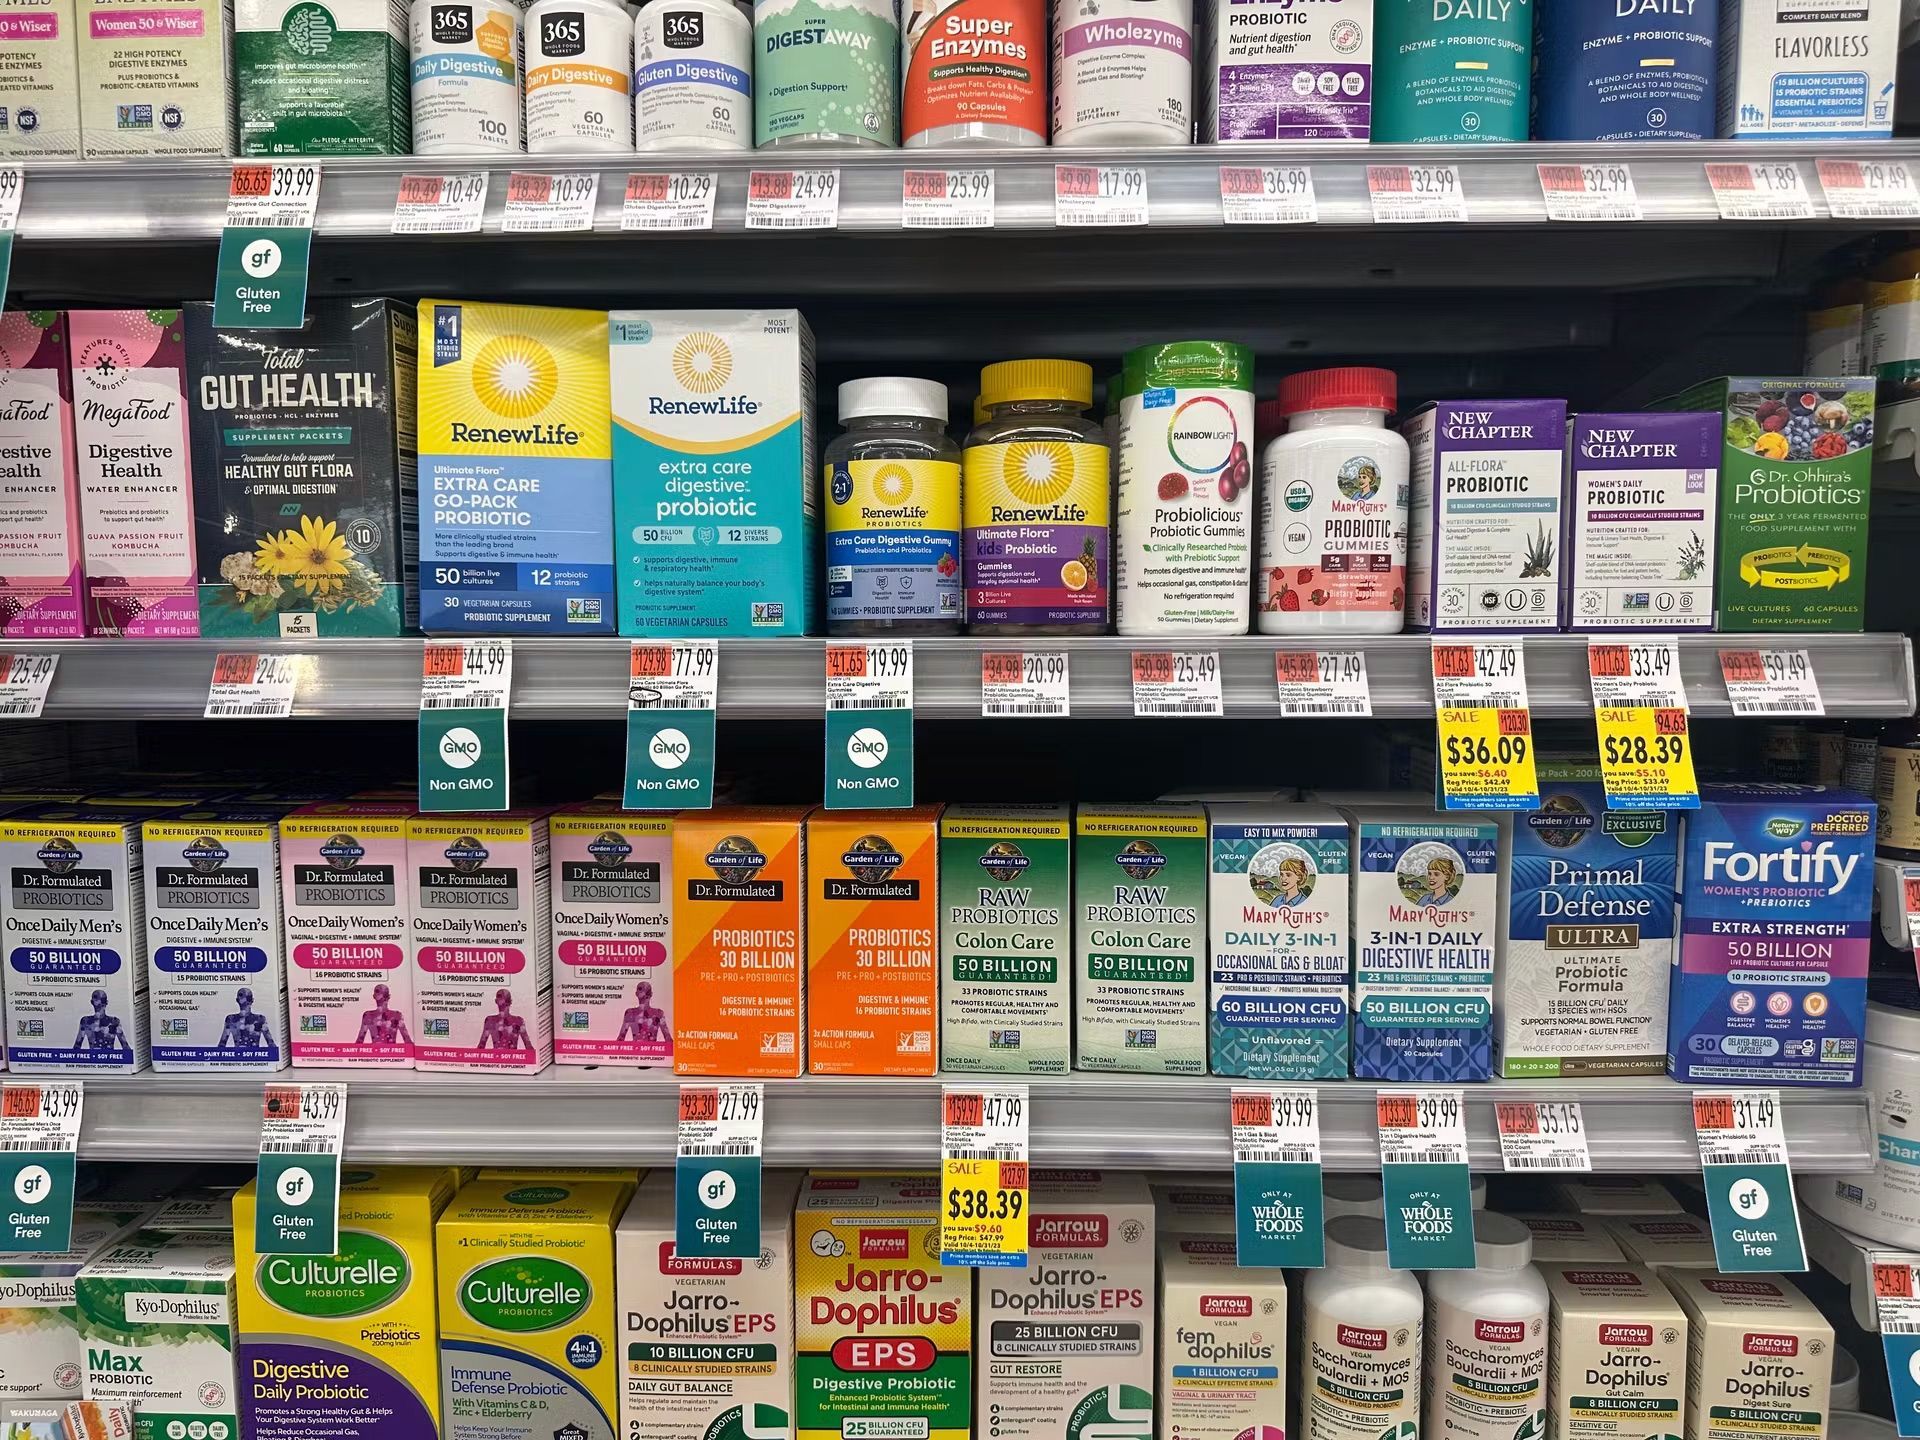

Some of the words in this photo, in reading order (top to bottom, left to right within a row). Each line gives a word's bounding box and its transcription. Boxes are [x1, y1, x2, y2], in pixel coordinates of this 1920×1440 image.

[1433, 0, 1512, 22] DAILY
[96, 19, 136, 30] Women
[139, 20, 154, 29] 50
[157, 20, 163, 28] &
[165, 18, 197, 29] Wiser
[435, 12, 468, 30] 365
[946, 16, 1013, 35] Super
[1230, 12, 1307, 26] PROBIOTIC
[1085, 23, 1183, 49] Wholezyme
[1230, 33, 1265, 44] Nutrient
[1268, 32, 1311, 45] digestion
[931, 37, 1026, 61] Enzymes
[1400, 39, 1437, 54] ENZYME
[1447, 37, 1496, 46] PROBIOTIC
[1498, 39, 1524, 54] SUPPORT
[1776, 35, 1869, 58] FLAVORLESS
[145, 50, 182, 58] POTENCY
[109, 60, 150, 68] DIGESTIVE
[151, 59, 187, 67] ENZYMES
[638, 69, 673, 86] Gluten
[676, 65, 738, 85] Digestive
[957, 102, 968, 111] 90
[970, 103, 1006, 112] Capsules
[233, 169, 268, 192] $66.65
[272, 168, 314, 196] $39.99
[1099, 172, 1141, 196] $17.99
[1263, 171, 1306, 195] $36.99
[1410, 170, 1454, 193] $32.99
[1755, 167, 1796, 190] $1.89
[792, 174, 835, 199] $24.99
[252, 250, 271, 268] gf
[236, 288, 280, 300] Gluten
[243, 301, 271, 313] Free
[1449, 412, 1492, 426] NEW
[233, 433, 294, 441] SUPPLEMENT
[89, 444, 172, 461] Digestive
[101, 464, 162, 477] Health
[225, 464, 279, 479] HEALTHY
[284, 465, 308, 478] GUT
[312, 463, 353, 477] FLORA
[659, 462, 707, 474] extra
[713, 463, 752, 474] care
[1770, 471, 1789, 483] Dr.
[1794, 469, 1851, 483] Ohhira's
[434, 477, 489, 491] EXTRA
[494, 478, 540, 492] CARE
[1588, 480, 1619, 488] WOMEN'S
[1622, 480, 1642, 488] DAILY
[1687, 480, 1704, 488] LOOK
[1588, 490, 1664, 504] PROBIOTIC
[657, 497, 757, 520] probiotic
[435, 511, 531, 525] PROBIOTIC
[1325, 519, 1391, 538] PROBIOTIC
[835, 537, 852, 545] Extra
[854, 535, 875, 545] Care
[878, 535, 922, 547] Digestive
[923, 536, 951, 547] Gummy
[1288, 533, 1305, 543] VEGAN
[1324, 541, 1389, 550] GUMMIES
[635, 618, 644, 626] 60
[645, 618, 689, 627] VEGETARIAN
[692, 618, 728, 627] CAPSULES
[464, 648, 505, 675] $44.99
[672, 648, 713, 676] $77.99
[1475, 648, 1516, 677] $42.49
[1630, 648, 1671, 677] $33.49
[1762, 655, 1806, 681] $59.49
[1023, 657, 1064, 683] $20.99
[1443, 711, 1480, 723] SALE
[1447, 735, 1526, 766] $36.09
[1605, 735, 1683, 766] $28.39
[1478, 769, 1507, 778] $6.40
[430, 779, 456, 791] Non
[458, 779, 493, 790] GMO
[1606, 819, 1662, 830] EXCLUSIVE
[5, 829, 15, 837] NO
[18, 829, 76, 837] REFRIGERATION
[78, 830, 116, 838] REQUIRED
[1547, 860, 1644, 886] Primal
[1704, 841, 1859, 895] Fortify
[23, 875, 39, 886] Dr.
[41, 874, 102, 887] Formulated
[712, 929, 795, 948] PROBIOTICS
[955, 932, 1007, 949] Colon
[1011, 934, 1054, 949] Care
[1225, 932, 1280, 946] DAILY
[1287, 933, 1336, 946] 3-IN-1
[1557, 928, 1631, 945] ULTRA
[29, 952, 46, 963] 50
[49, 952, 101, 964] BILLION
[719, 951, 737, 968] 30
[741, 951, 795, 969] BILLION
[1564, 956, 1621, 964] ULTIMATE
[1555, 966, 1628, 979] Probiotic
[1743, 974, 1789, 982] PROBIOTIC
[1791, 975, 1826, 983] STRAINS
[973, 988, 1013, 996] PROBIOTIC
[1558, 980, 1623, 993] Formula
[1222, 1002, 1241, 1013] 60
[1245, 1003, 1305, 1014] BILLION
[1310, 1003, 1341, 1014] CFU
[41, 1090, 78, 1118] $43.99
[719, 1092, 758, 1121] $27.99
[1272, 1098, 1312, 1127] $39.99
[1732, 1099, 1773, 1129] $31.49
[948, 1187, 1022, 1221] $38.39
[1252, 1206, 1304, 1220] WHOLE
[1255, 1219, 1303, 1232] FOODS
[305, 1289, 365, 1298] PROBIOTICS
[88, 1348, 143, 1372] Max
[650, 1346, 665, 1358] 10
[668, 1347, 724, 1359] BILLION
[726, 1348, 754, 1359] CFU
[852, 1344, 916, 1367] EPS
[253, 1359, 349, 1380] Digestive
[90, 1374, 153, 1385] PROBIOTIC
[813, 1377, 884, 1392] Digestive
[888, 1377, 956, 1390] Probiotic
[254, 1385, 292, 1402] Daily
[296, 1384, 369, 1399] Probiotic
[1606, 1389, 1620, 1397] Gut
[1622, 1389, 1644, 1398] Calm
[1590, 1400, 1596, 1408] 8
[1598, 1400, 1637, 1408] BILLION
[1639, 1400, 1659, 1409] CFU
